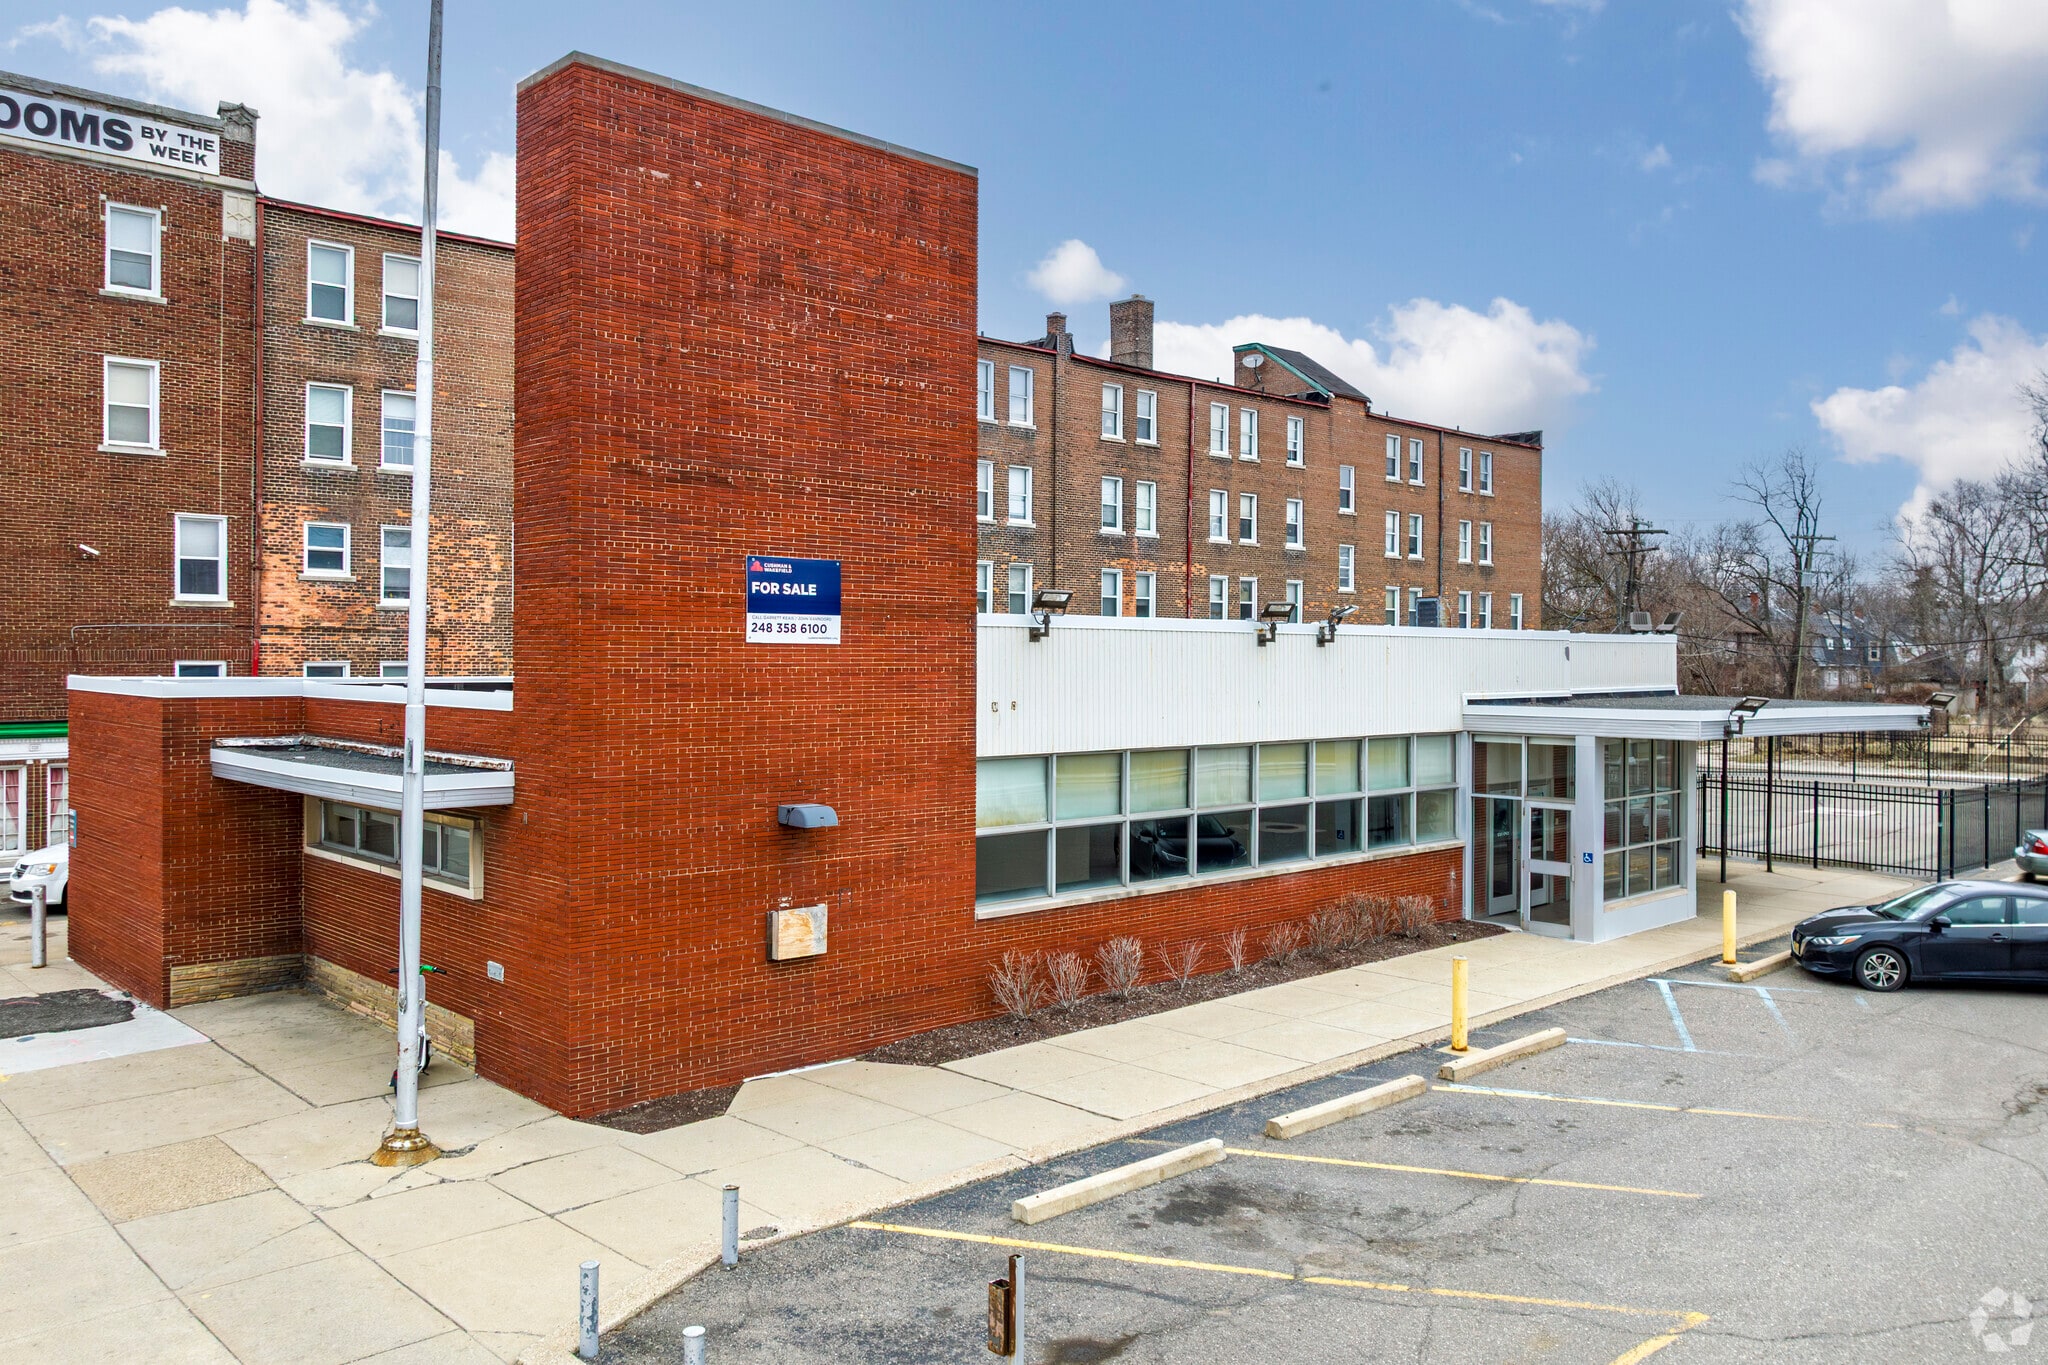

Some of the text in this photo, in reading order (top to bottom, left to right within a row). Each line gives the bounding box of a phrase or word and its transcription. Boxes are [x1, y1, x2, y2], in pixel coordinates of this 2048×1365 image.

[141, 125, 216, 153] BY THE
[149, 142, 209, 167] WEEK
[751, 581, 817, 596] FOR SALE
[751, 622, 828, 634] 248 358 6100
